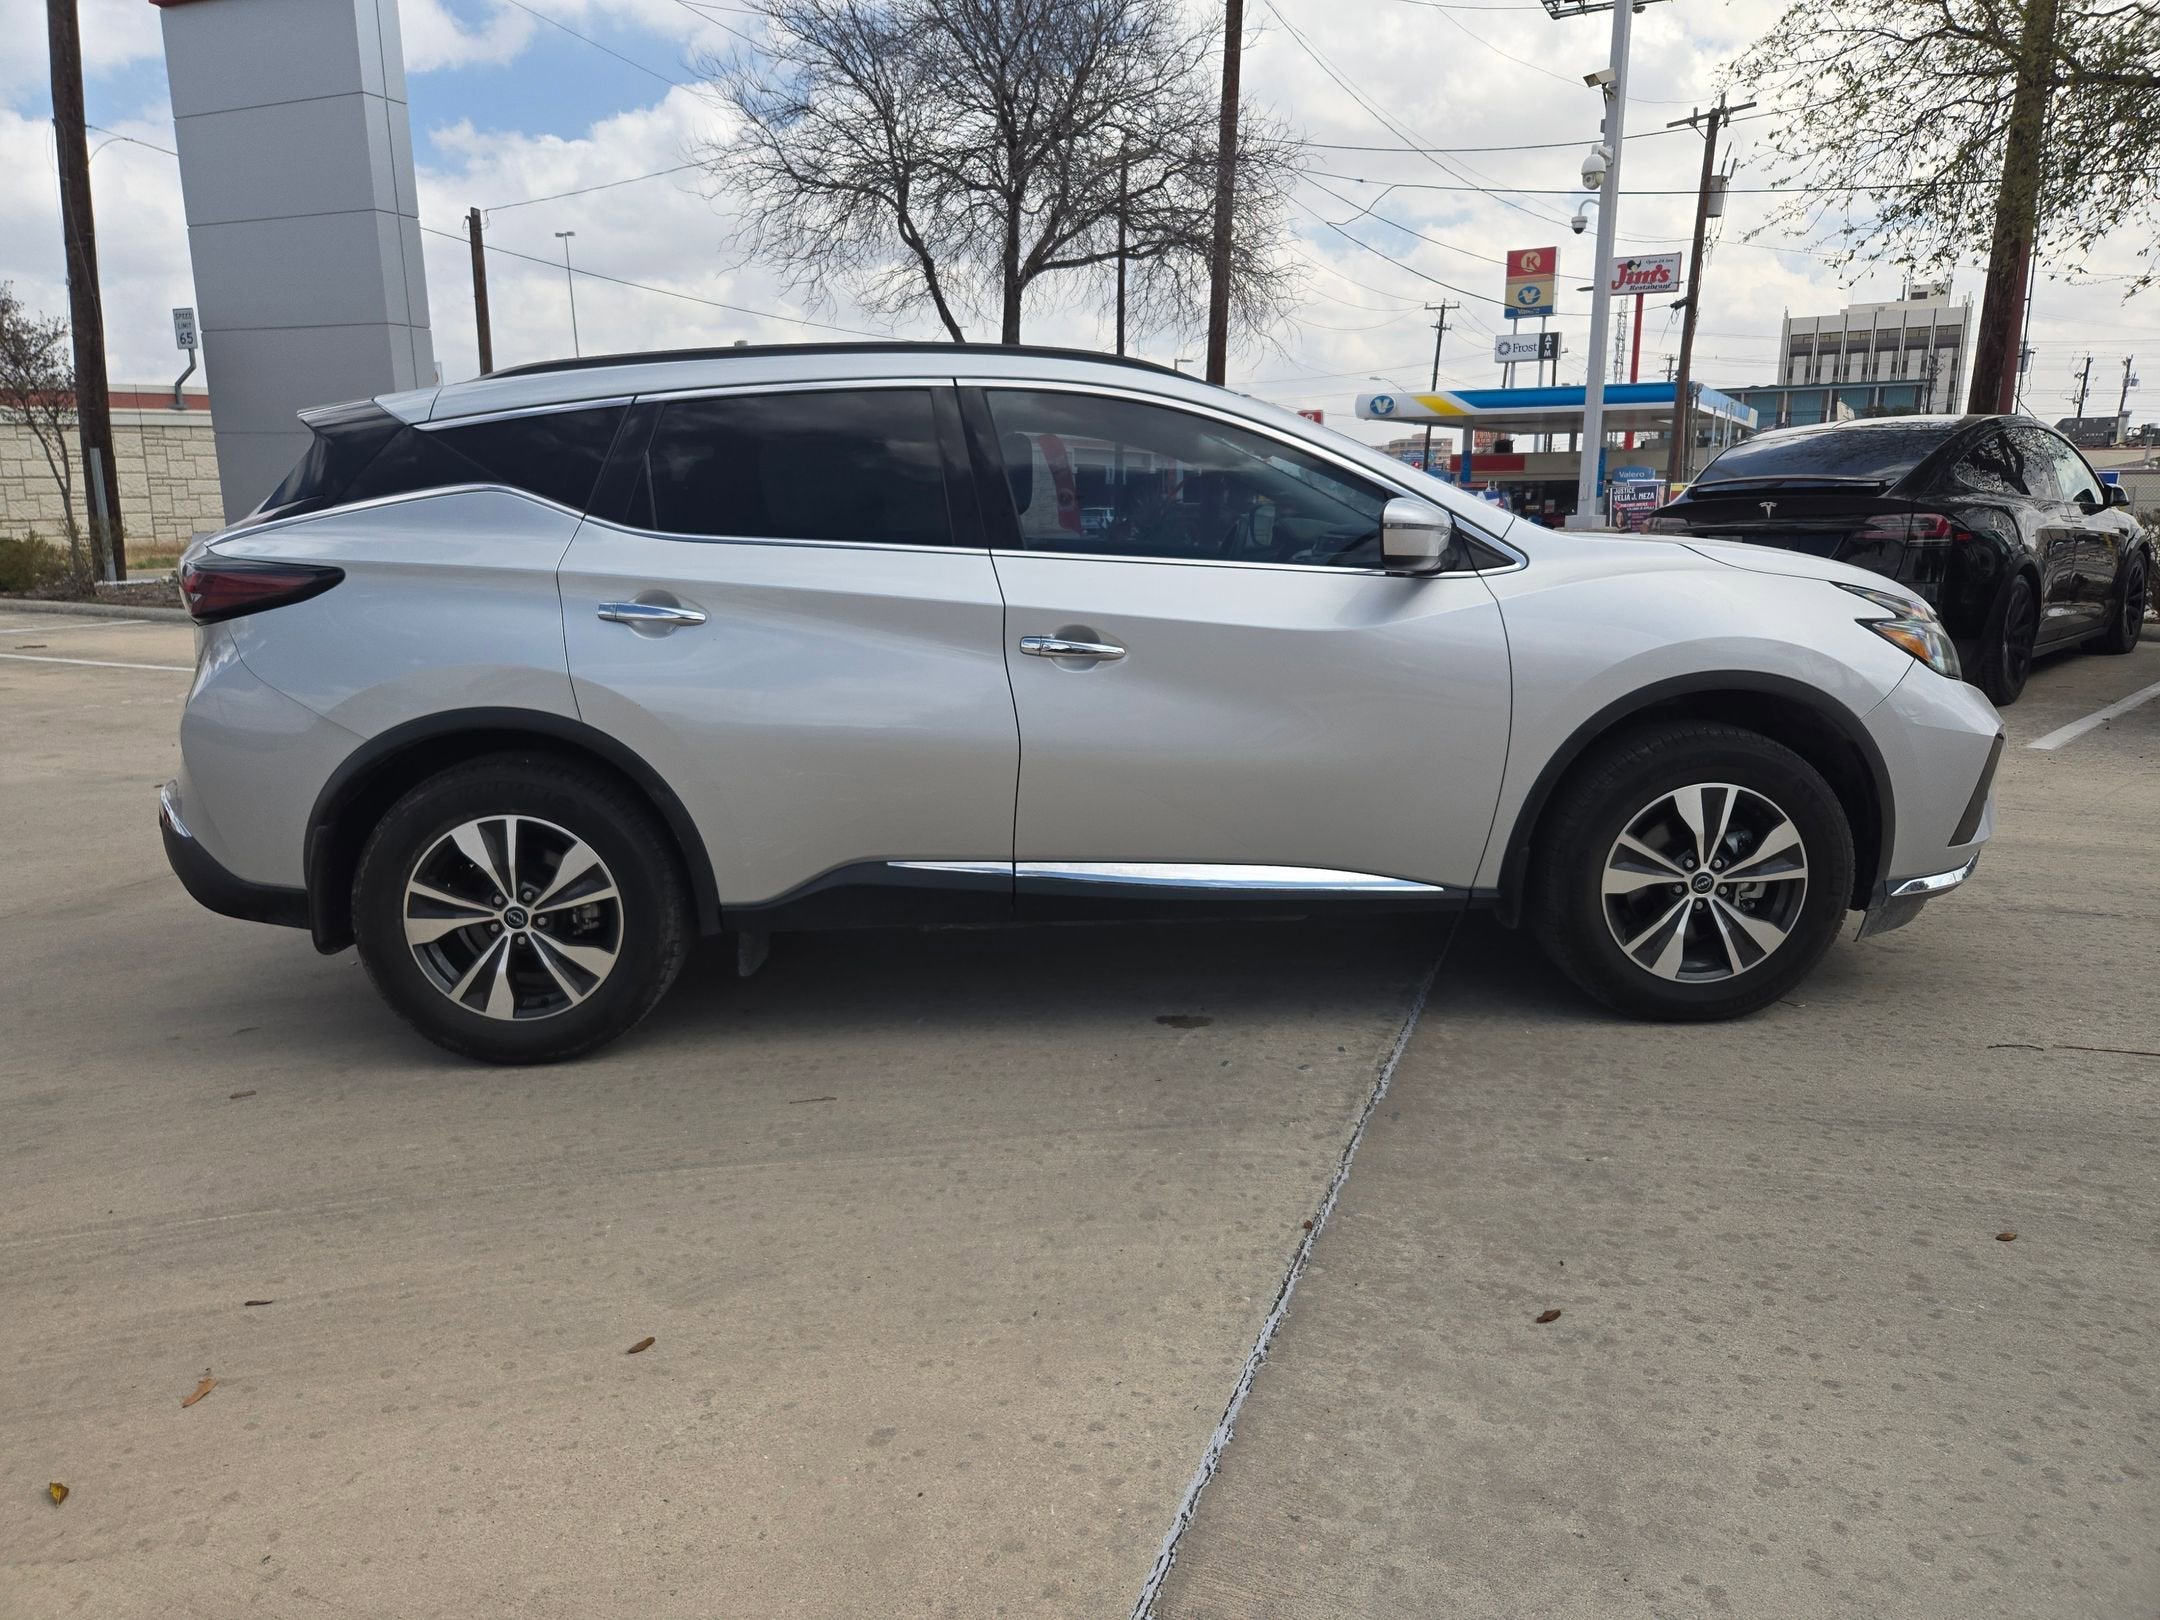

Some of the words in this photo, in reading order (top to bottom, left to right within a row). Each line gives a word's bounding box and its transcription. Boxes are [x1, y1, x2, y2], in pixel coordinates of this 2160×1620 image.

[1611, 263, 1671, 290] Jim's
[1629, 281, 1672, 292] Restaurant
[180, 332, 193, 344] 65
[1512, 342, 1537, 352] Frost
[1543, 334, 1552, 357] ATM
